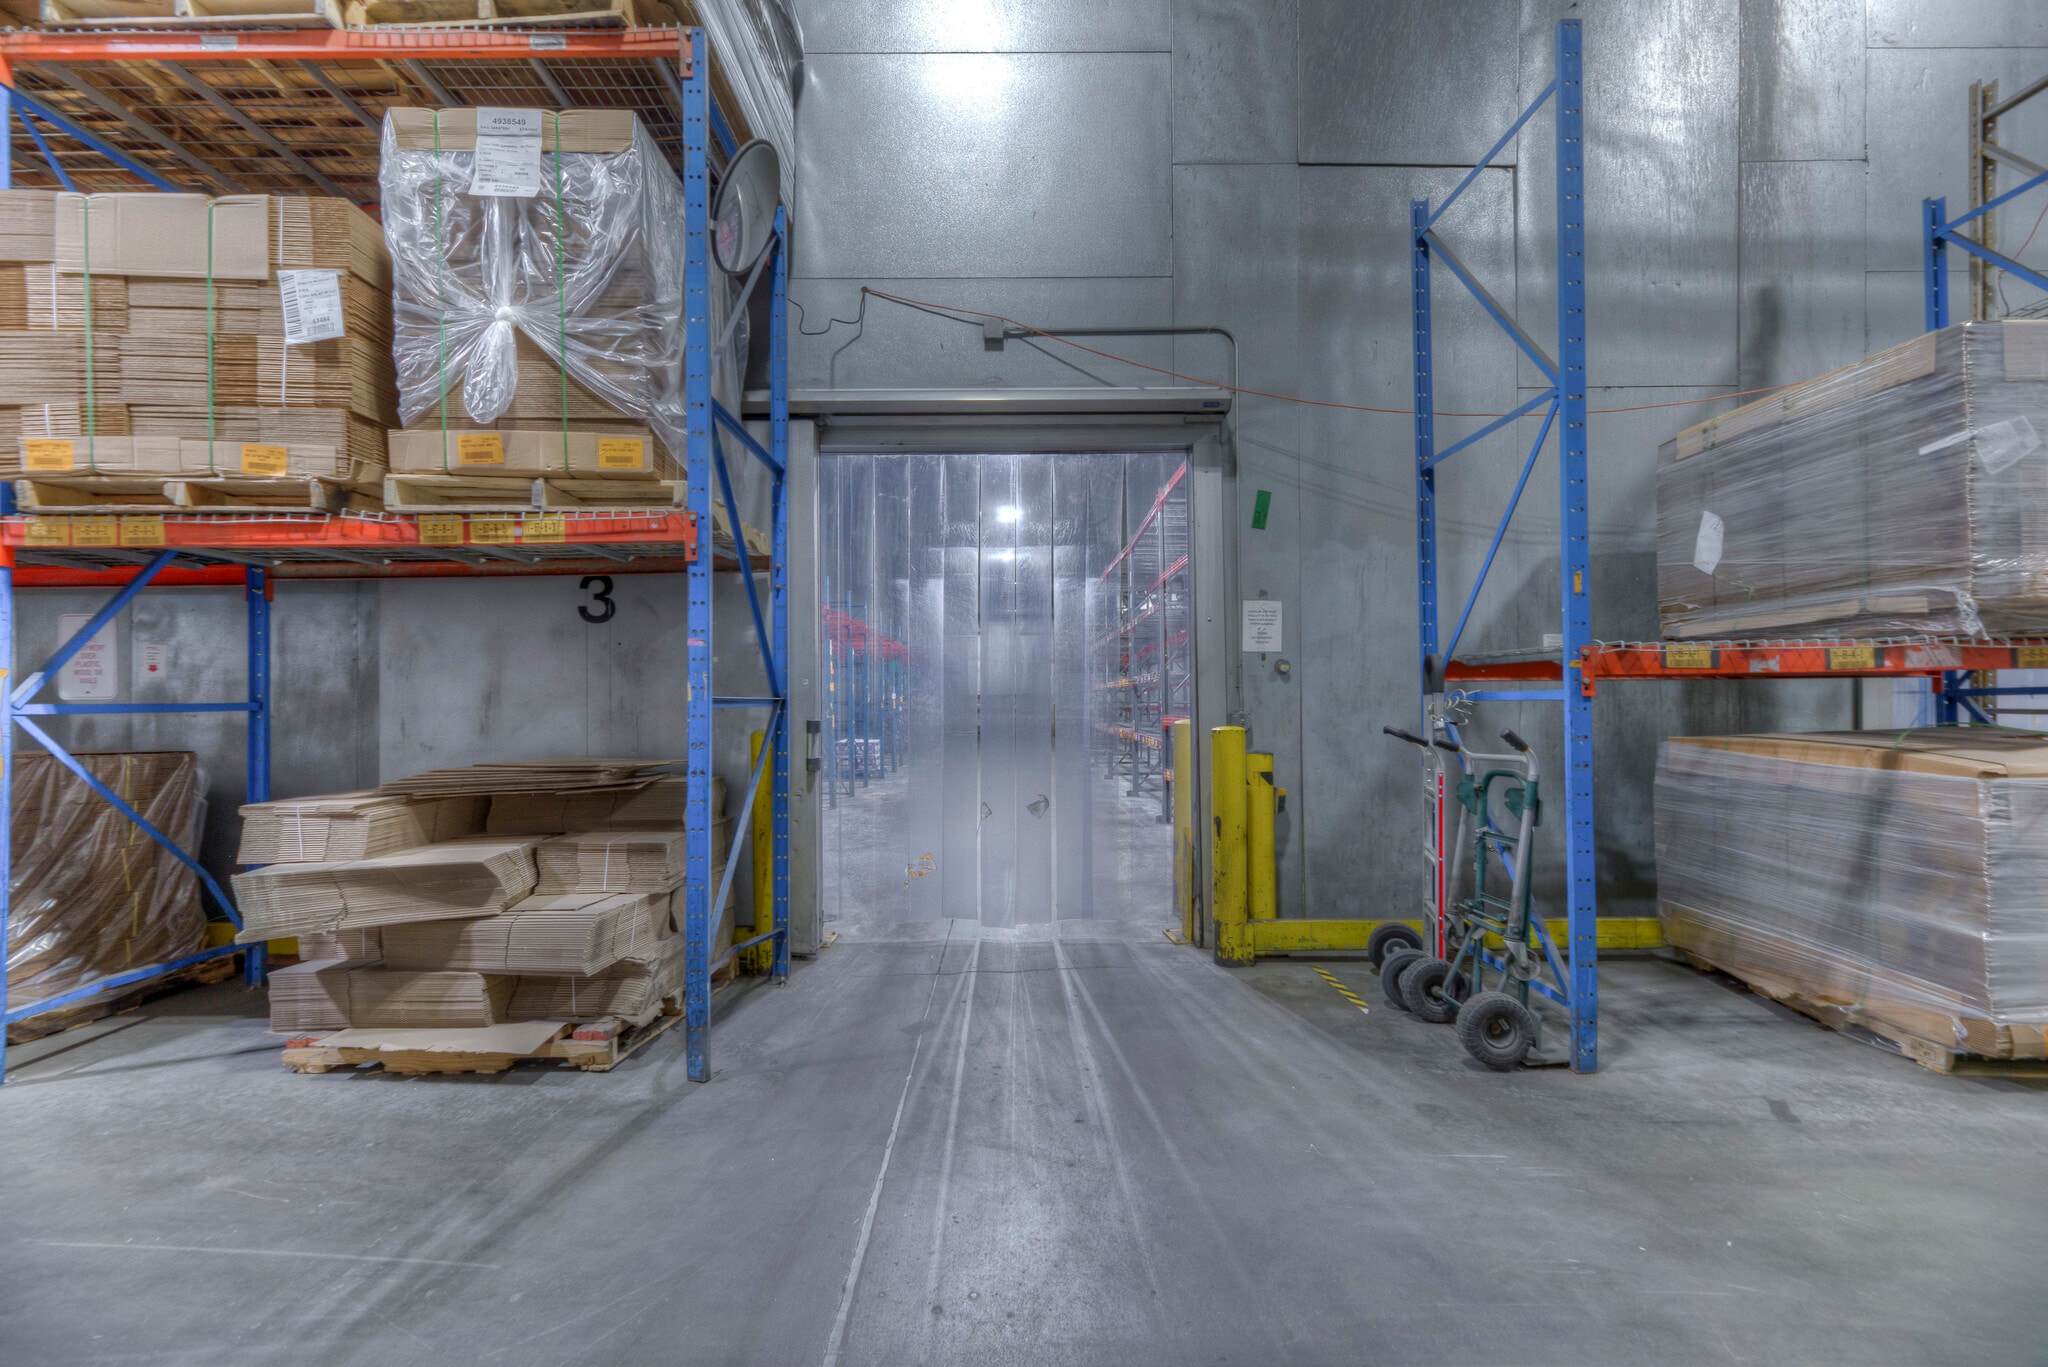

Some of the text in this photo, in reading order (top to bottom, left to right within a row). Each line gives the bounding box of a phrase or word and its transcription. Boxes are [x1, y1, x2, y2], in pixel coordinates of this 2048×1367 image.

[492, 117, 527, 126] 4938549
[312, 316, 330, 325] 63484
[577, 575, 616, 624] 3
